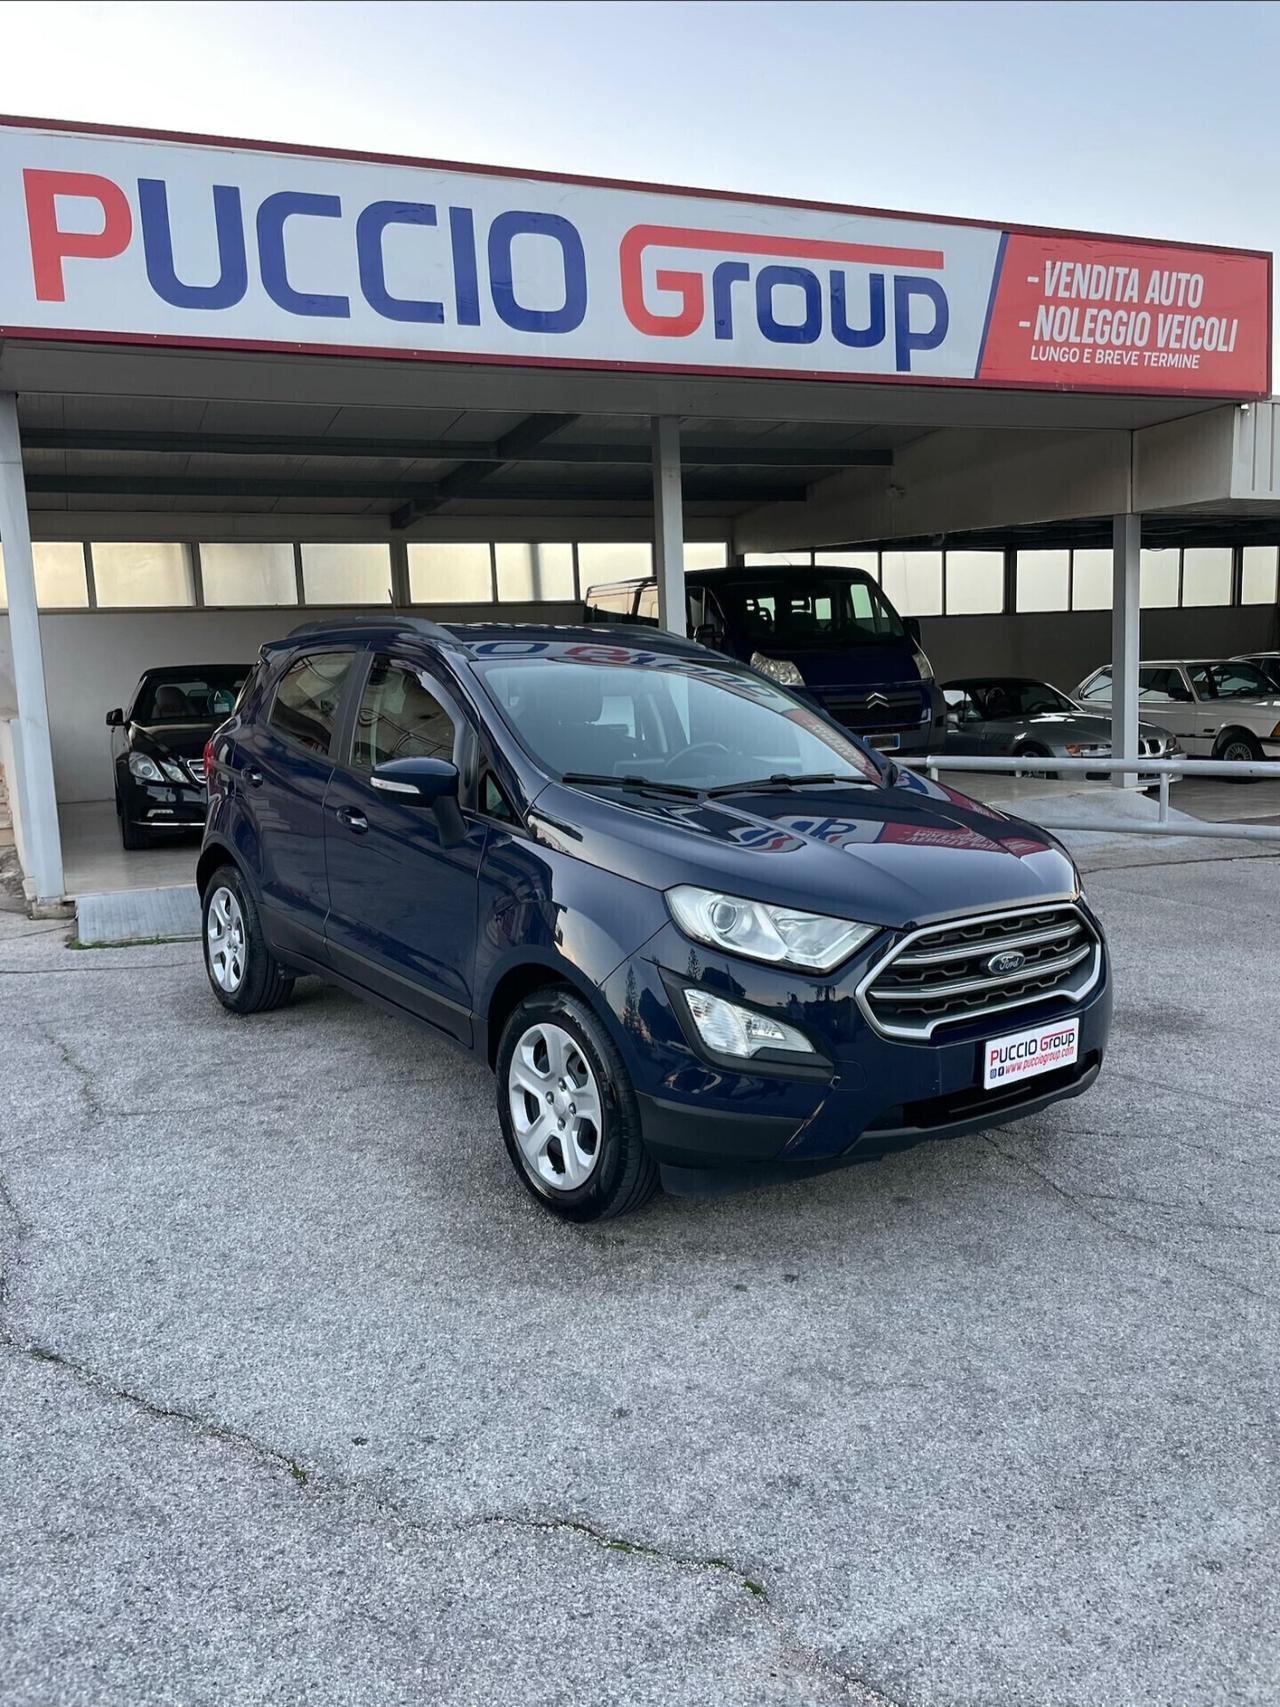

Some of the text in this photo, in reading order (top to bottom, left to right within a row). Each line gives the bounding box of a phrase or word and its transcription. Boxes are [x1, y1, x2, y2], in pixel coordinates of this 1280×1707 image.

[23, 168, 949, 372] PUCCIO Group
[1144, 270, 1204, 309] AUTO
[1157, 313, 1238, 352] VEICOLI
[1030, 345, 1200, 369] LUNGO E BREVE TERMINE
[999, 955, 1020, 970] Ford
[990, 1028, 1075, 1066] PUCCIO Group
[1005, 1046, 1075, 1074] www.pucciogroup.com
